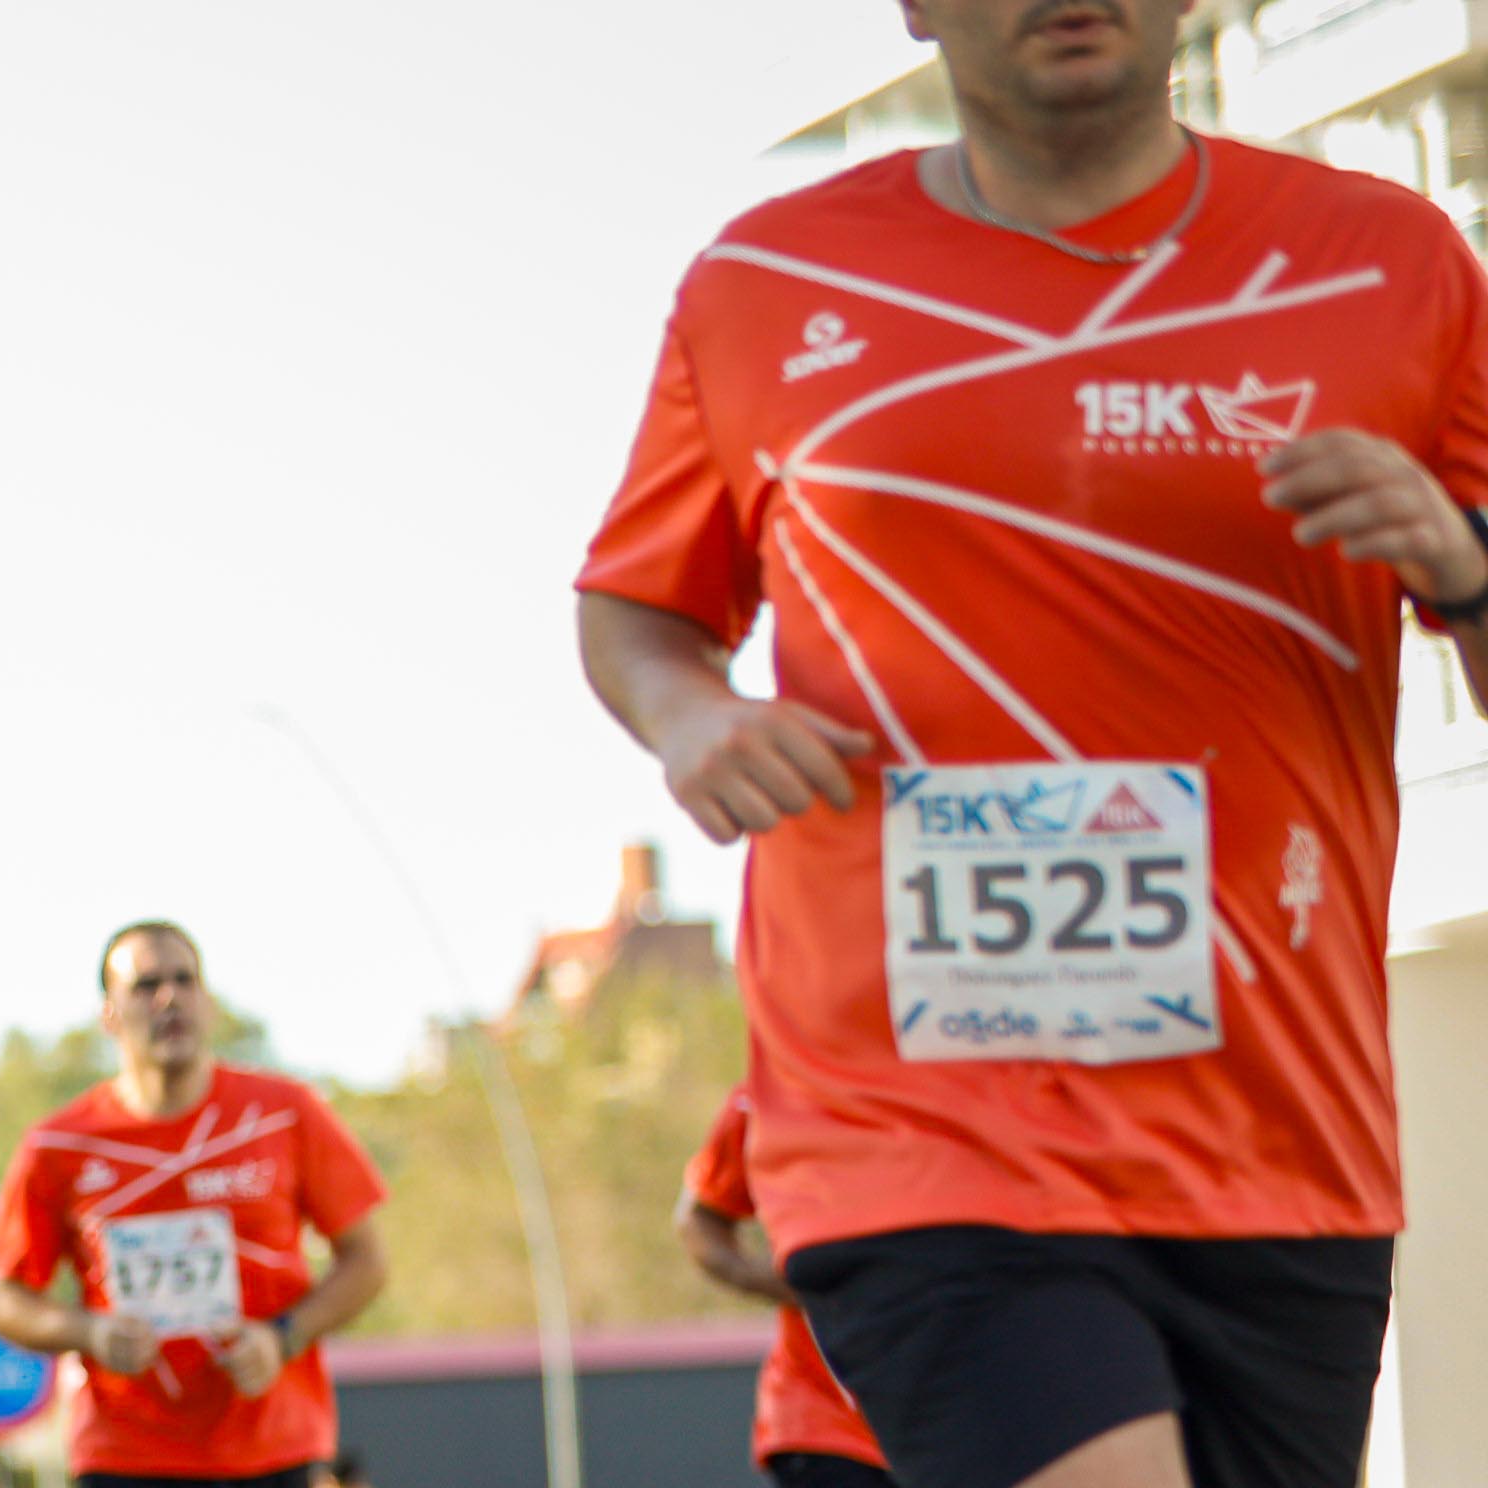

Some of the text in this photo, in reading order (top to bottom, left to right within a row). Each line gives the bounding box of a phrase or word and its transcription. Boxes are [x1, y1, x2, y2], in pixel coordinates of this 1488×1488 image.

[1075, 383, 1196, 437] 15K
[914, 792, 990, 834] 15K
[902, 856, 1188, 953] 1525
